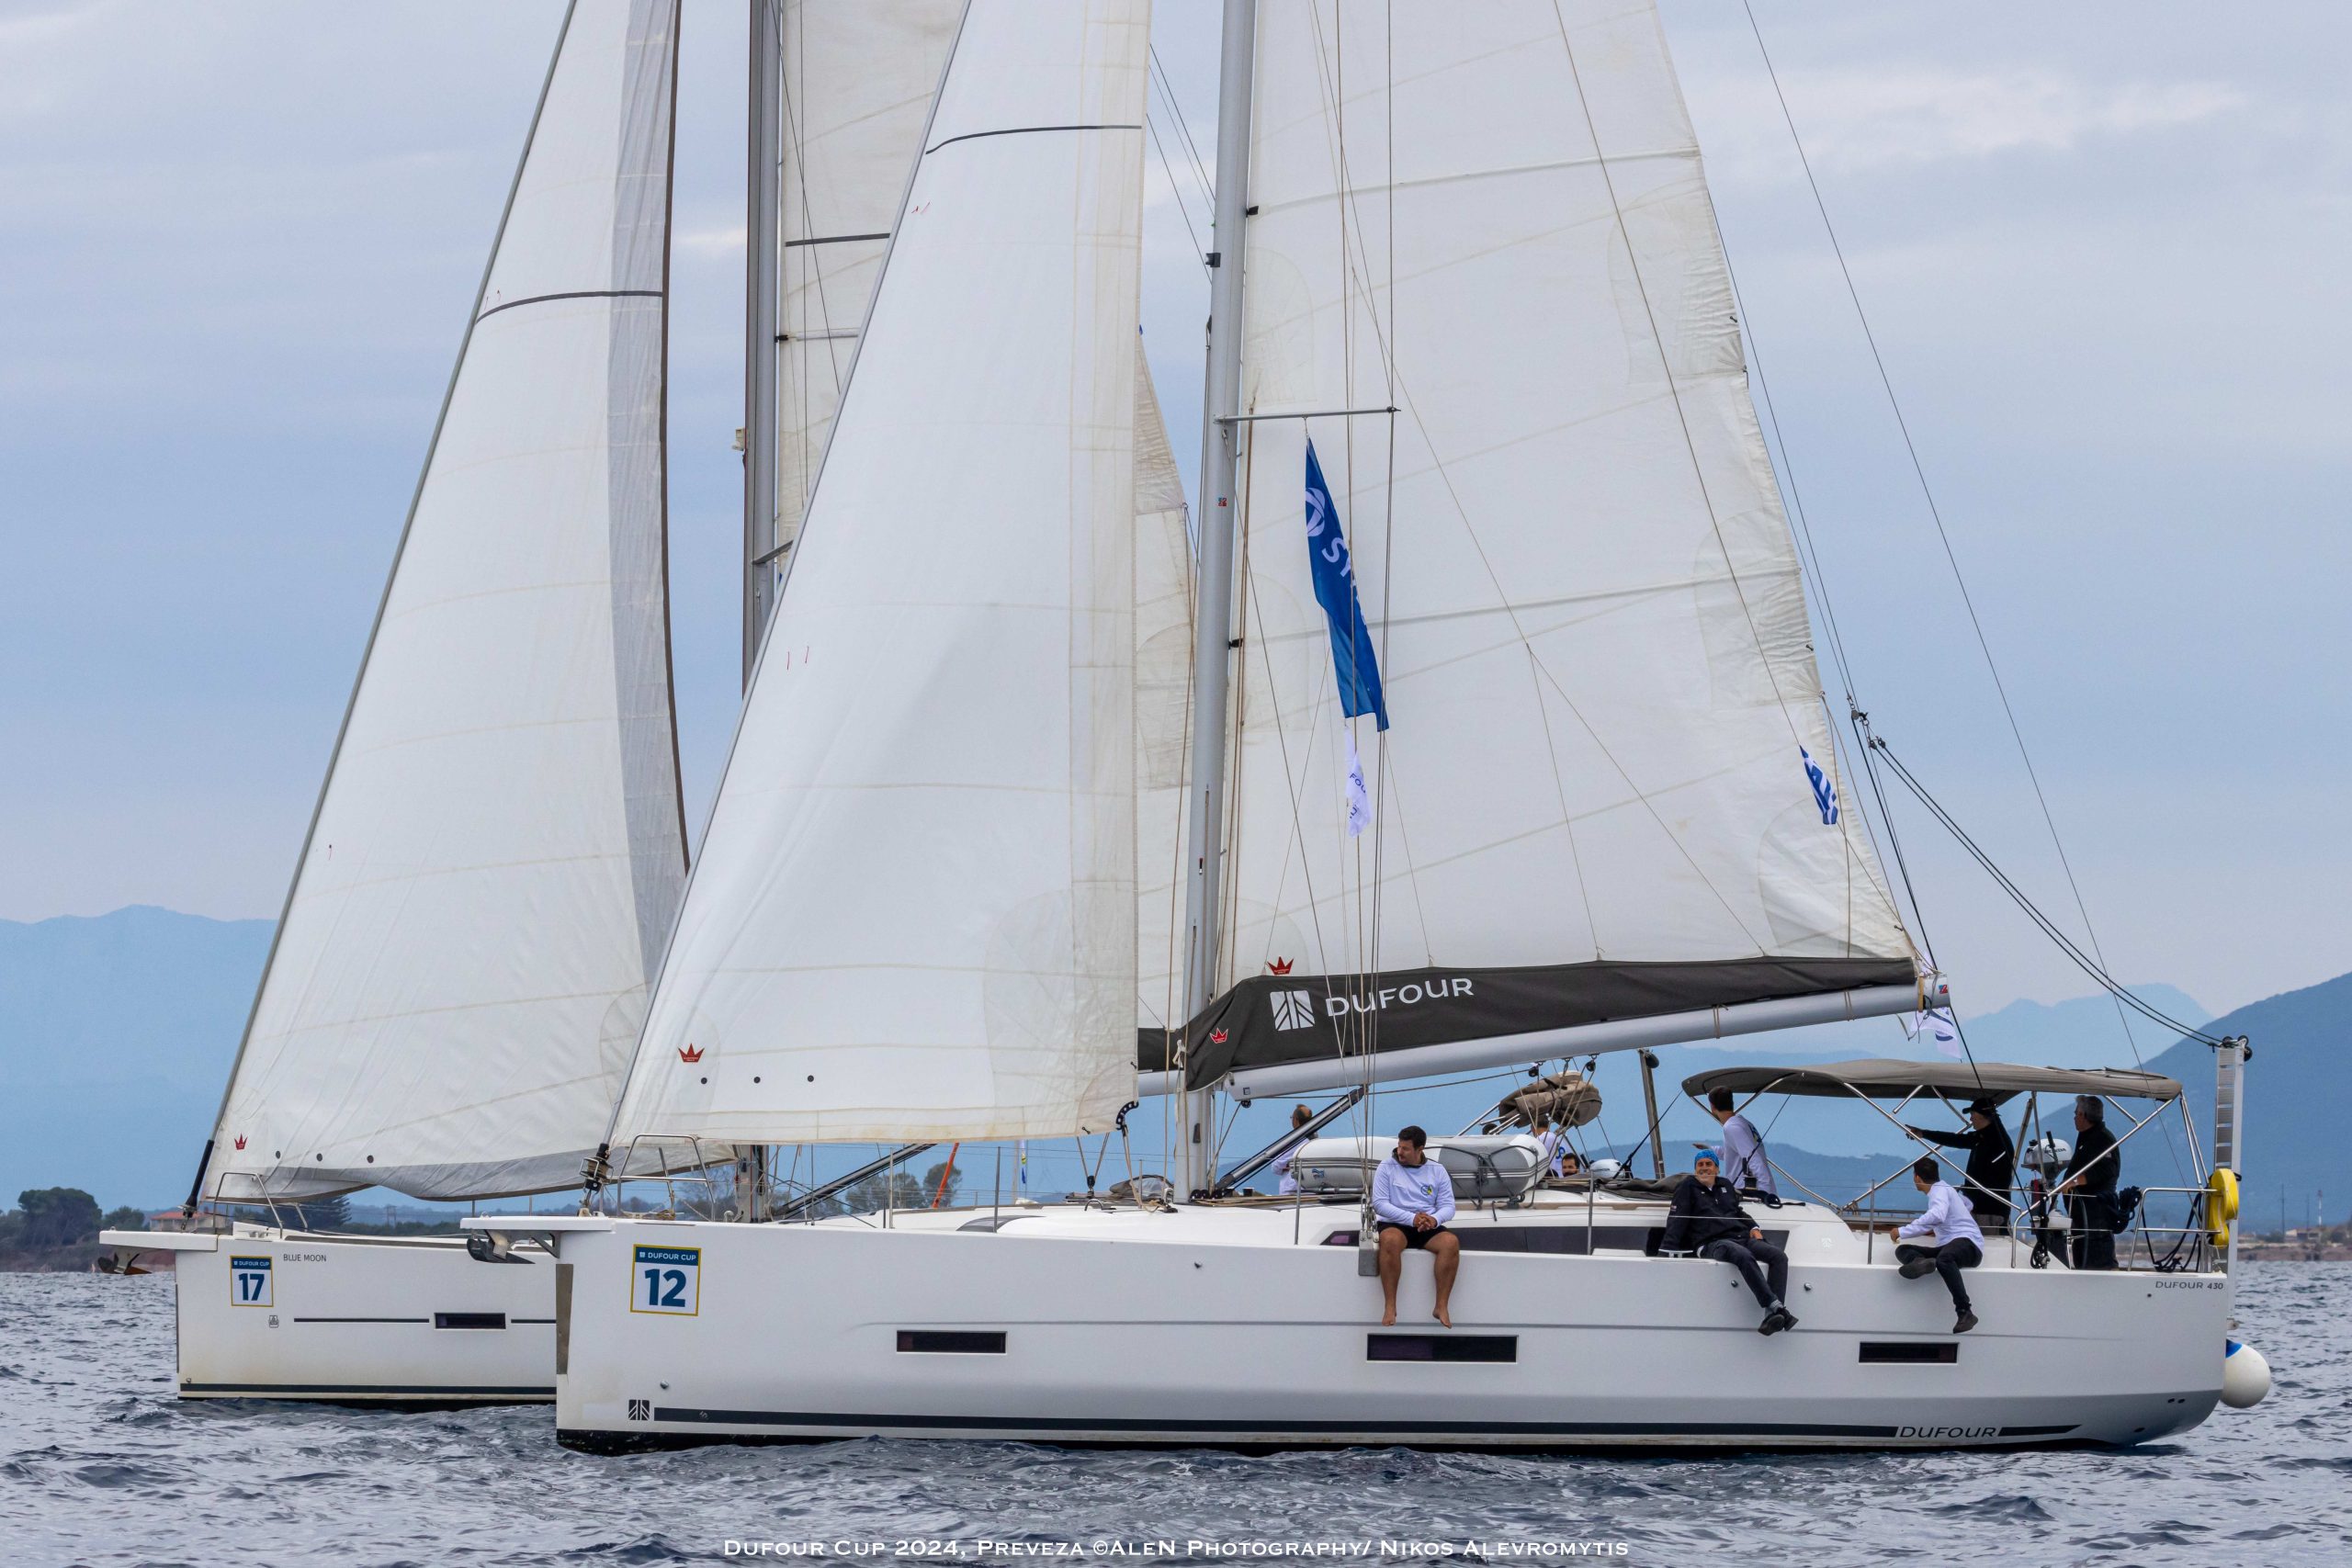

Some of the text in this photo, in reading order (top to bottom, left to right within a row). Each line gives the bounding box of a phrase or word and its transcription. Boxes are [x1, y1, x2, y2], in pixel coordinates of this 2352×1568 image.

[1325, 977, 1474, 1017] DUFOUR
[283, 1253, 327, 1262] BLUE MOON
[238, 1273, 265, 1301] 17
[644, 1269, 686, 1307] 12
[1899, 1427, 1996, 1438] DUFOUR
